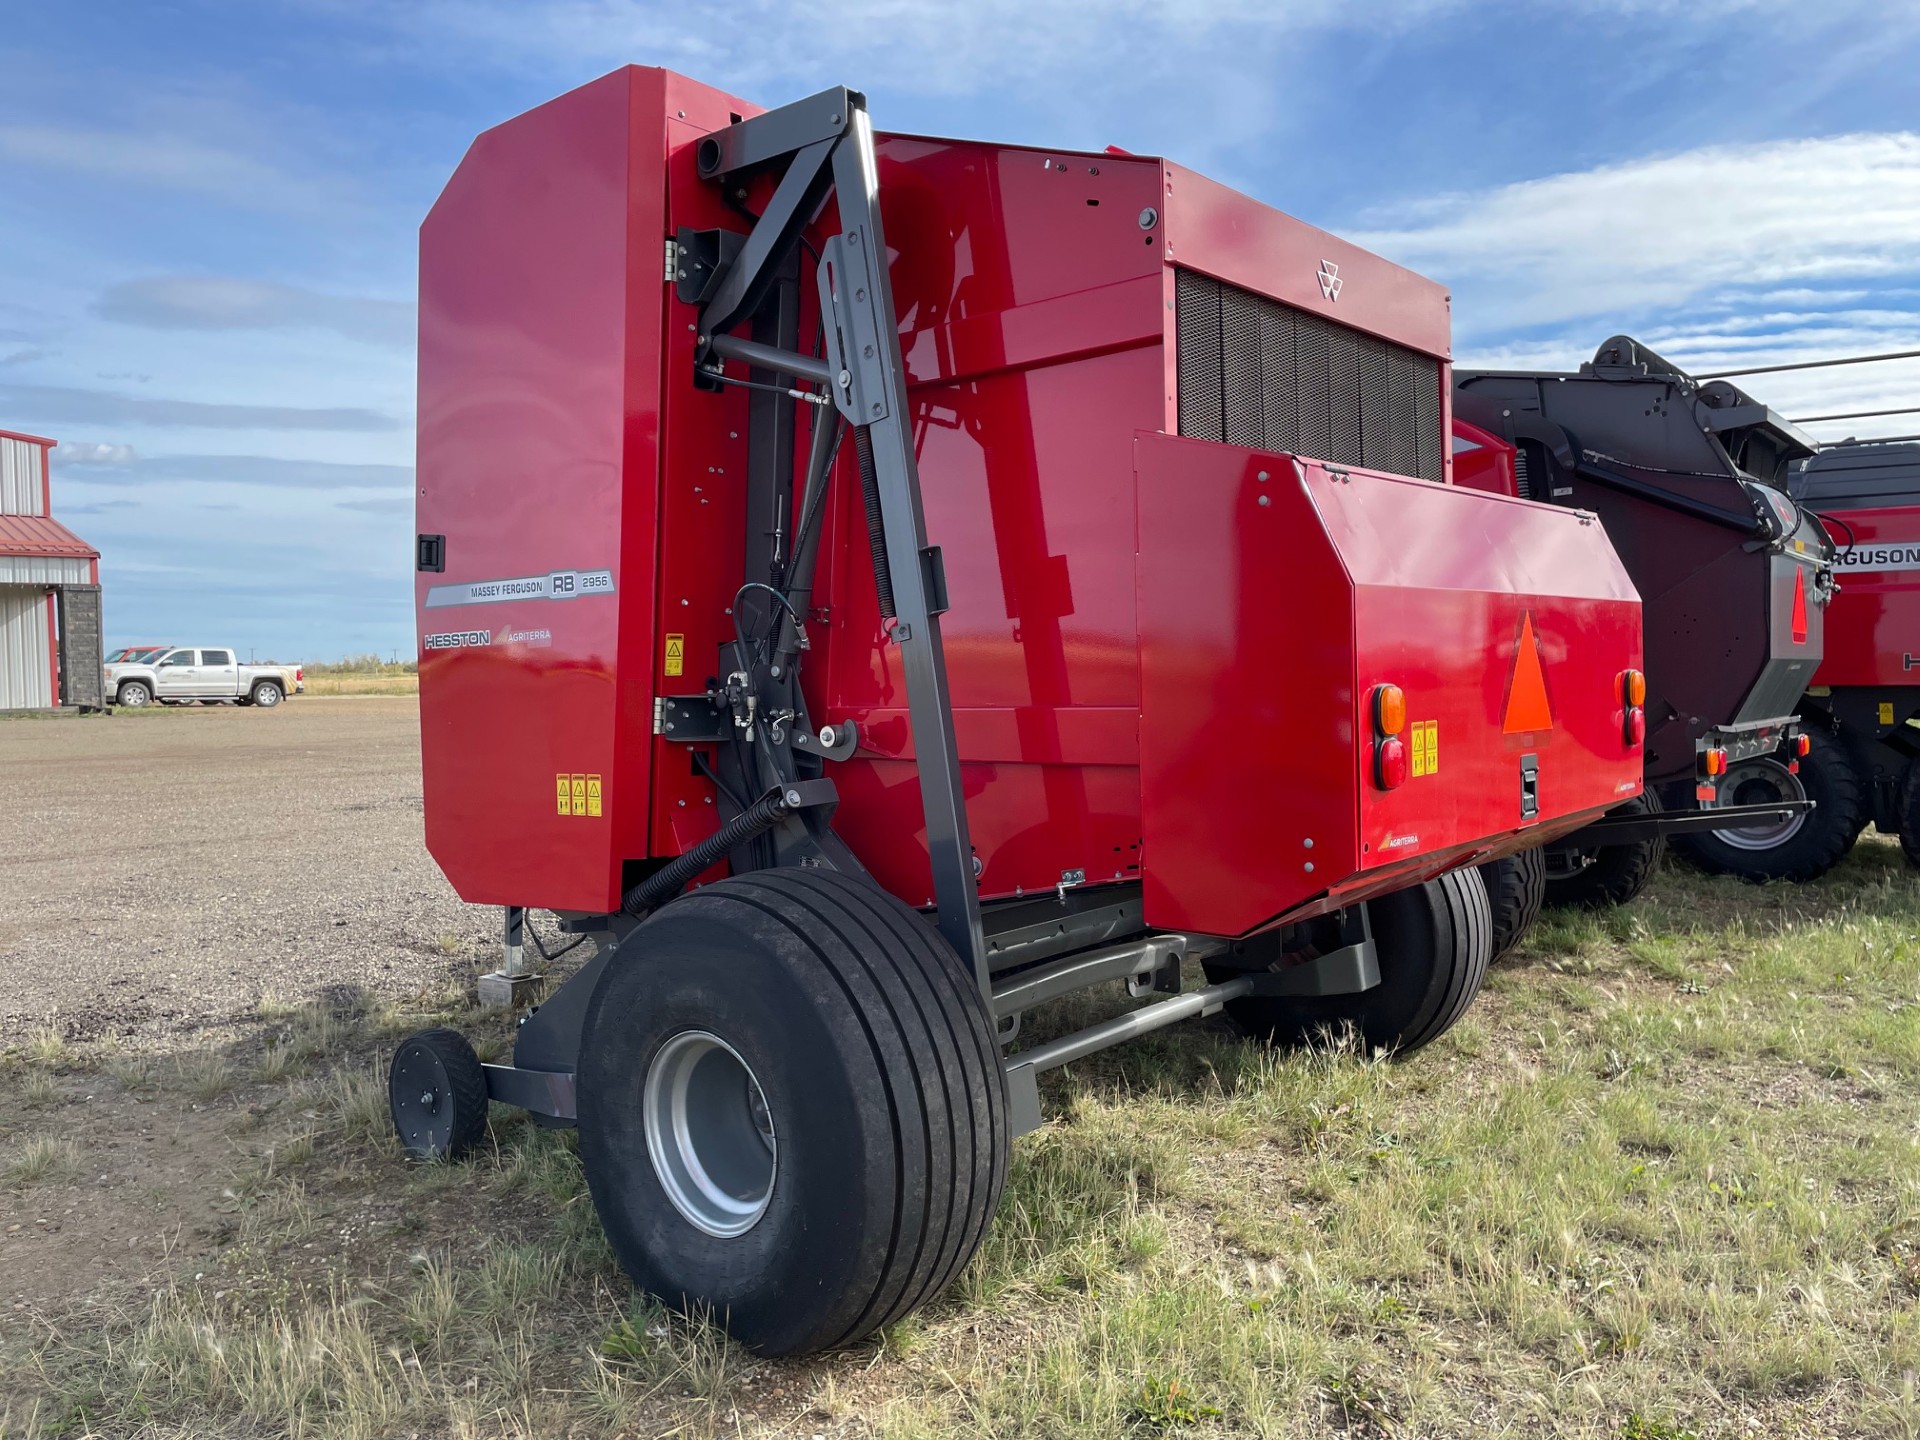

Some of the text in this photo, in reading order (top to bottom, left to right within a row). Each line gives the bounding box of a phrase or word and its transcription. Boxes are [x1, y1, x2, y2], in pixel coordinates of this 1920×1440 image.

[471, 574, 607, 598] MASSEY FERGUSON RB 2956
[425, 630, 551, 649] HESSTON AGRITERRA
